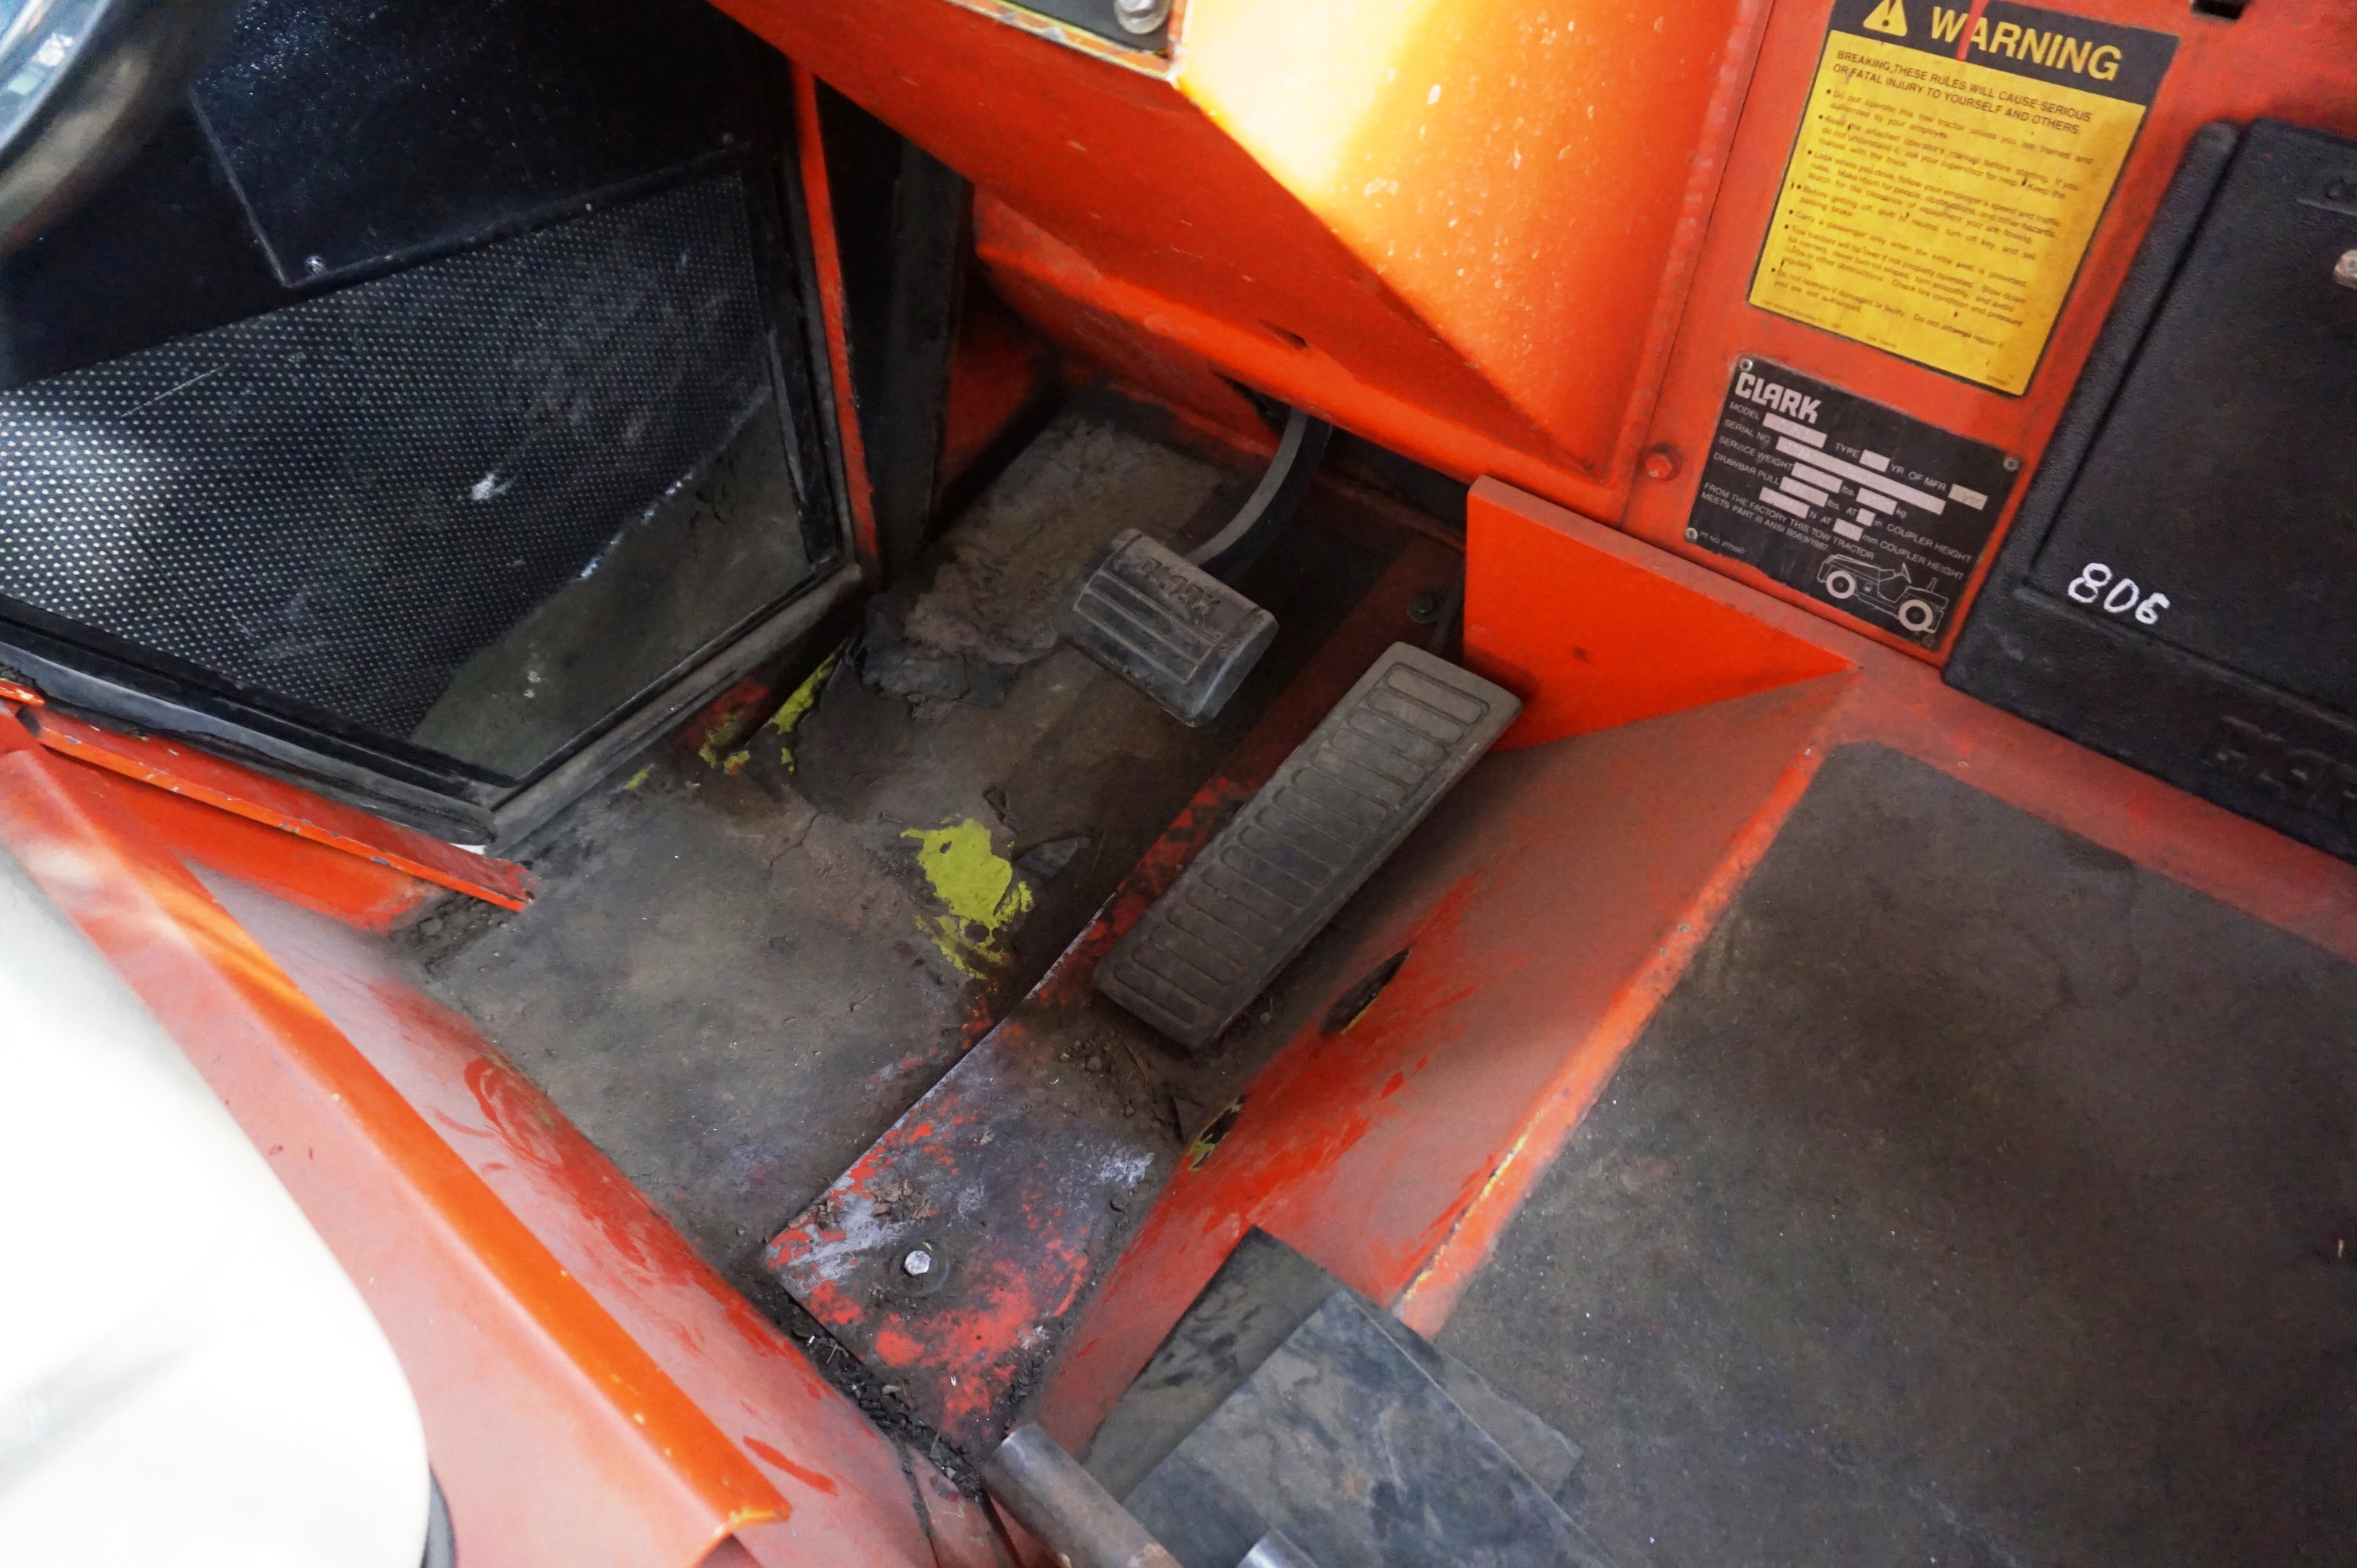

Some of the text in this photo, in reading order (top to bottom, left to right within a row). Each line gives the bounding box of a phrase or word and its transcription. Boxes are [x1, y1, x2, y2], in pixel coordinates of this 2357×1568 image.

[1930, 6, 2122, 81] WARNING
[1833, 64, 1848, 74] OR
[1851, 69, 1883, 82] FATAL
[1886, 78, 1922, 92] INJURY
[1927, 87, 1941, 98] TO
[1945, 93, 2001, 113] YOURSELF
[2005, 109, 2029, 120] AND
[1837, 51, 2091, 121] BREAKING THESE RULES WILL CAUSE SERIOUS
[1724, 419, 1755, 436] SERIAL
[1735, 372, 1821, 423] CLARK
[1719, 435, 1755, 456] SERVICE
[1758, 451, 1793, 471] WEIGHT
[1895, 507, 1907, 518] kg
[1729, 401, 1761, 419] MODEL
[1834, 443, 1860, 458] TYPE
[1908, 471, 1922, 482] OF
[1924, 477, 1948, 492] MFR.
[1701, 492, 1729, 508] MEETS
[1732, 505, 1753, 518] PART
[1763, 518, 1784, 532] ANSI
[1704, 482, 1875, 559] FROM THE FACTORY THIS TOW TRACTOR
[1714, 453, 1755, 474] DRAWBAR
[1758, 470, 1780, 484] PULL
[1826, 499, 1841, 510] lbs.
[1846, 506, 1858, 516] AT
[1886, 523, 1932, 547] COUPLER
[1934, 542, 1971, 562] HEIGHT
[1808, 510, 1963, 580] N AT mm COUPLER HEIGHT
[2068, 562, 2170, 624] 806
